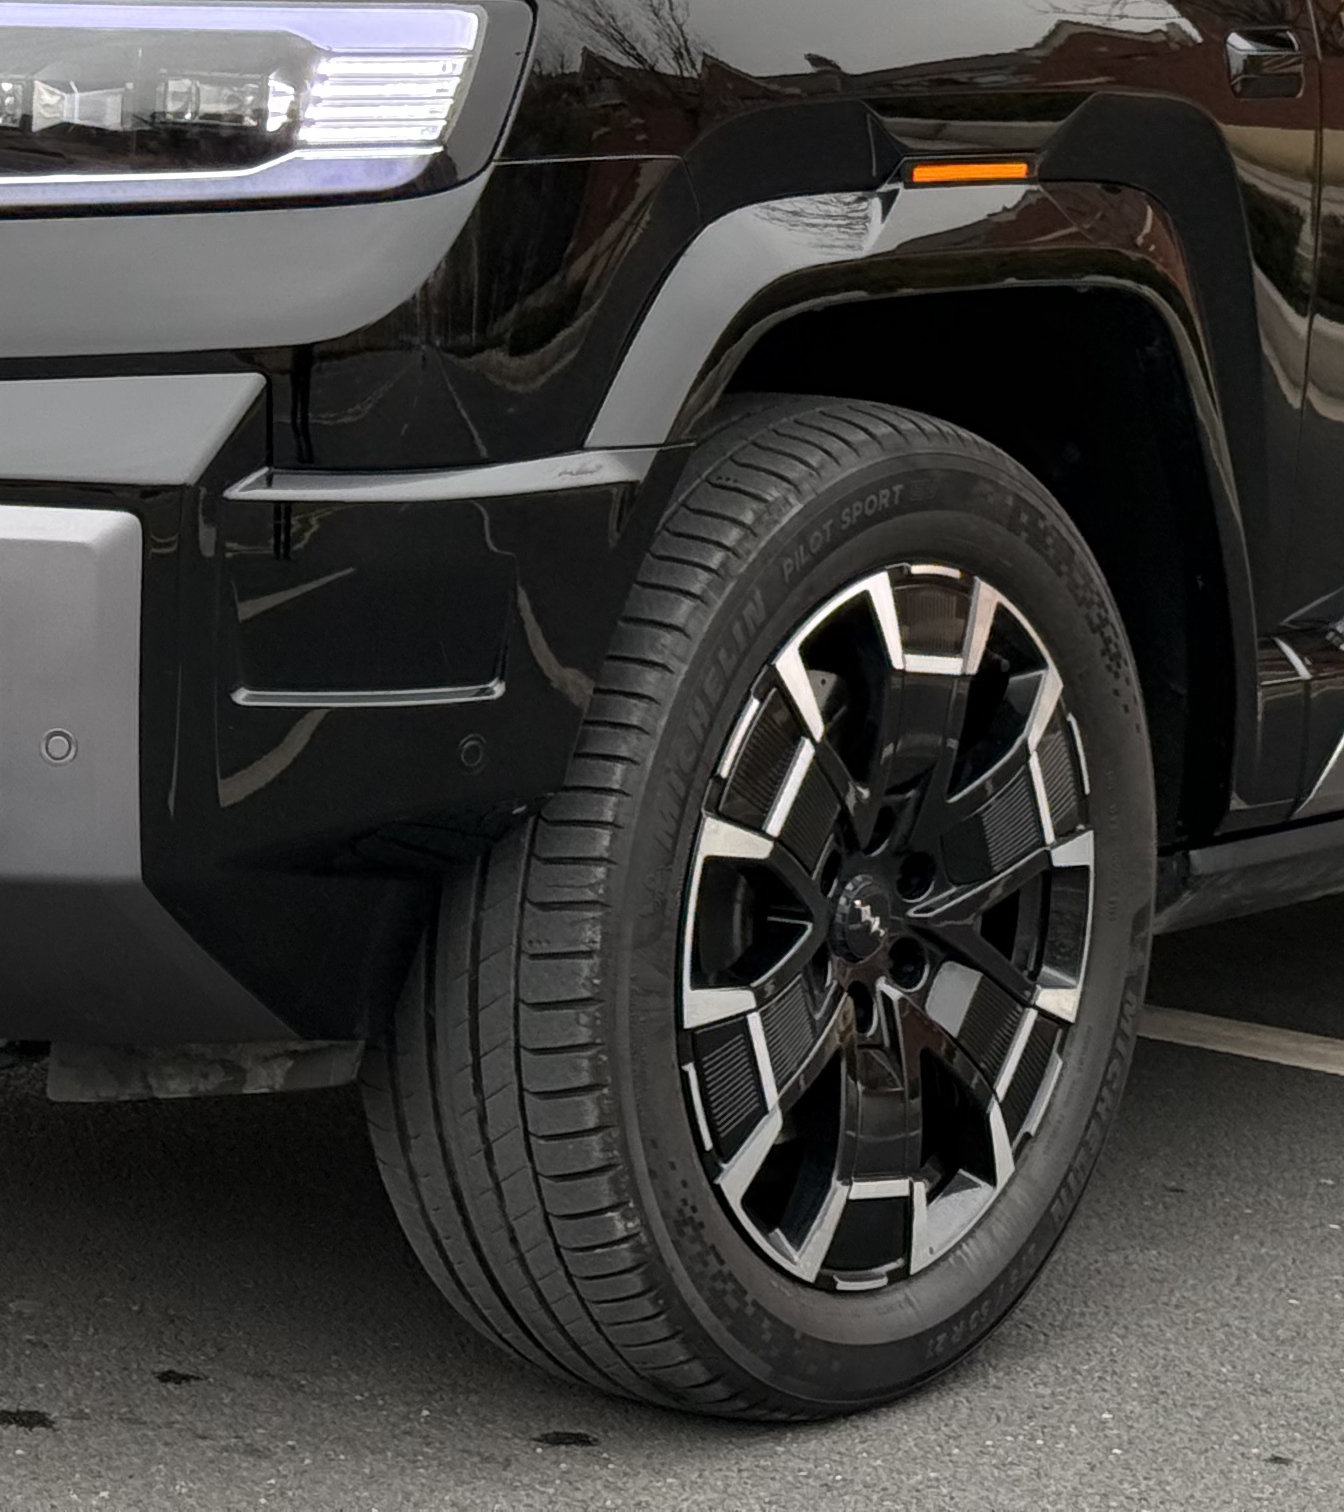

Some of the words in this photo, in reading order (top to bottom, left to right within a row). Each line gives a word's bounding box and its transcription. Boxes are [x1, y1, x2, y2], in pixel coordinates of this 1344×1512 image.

[780, 518, 835, 584] PILOT
[839, 483, 906, 531] SPORT
[653, 587, 768, 855] MICHELIN
[1051, 989, 1138, 1229] MICHELIN
